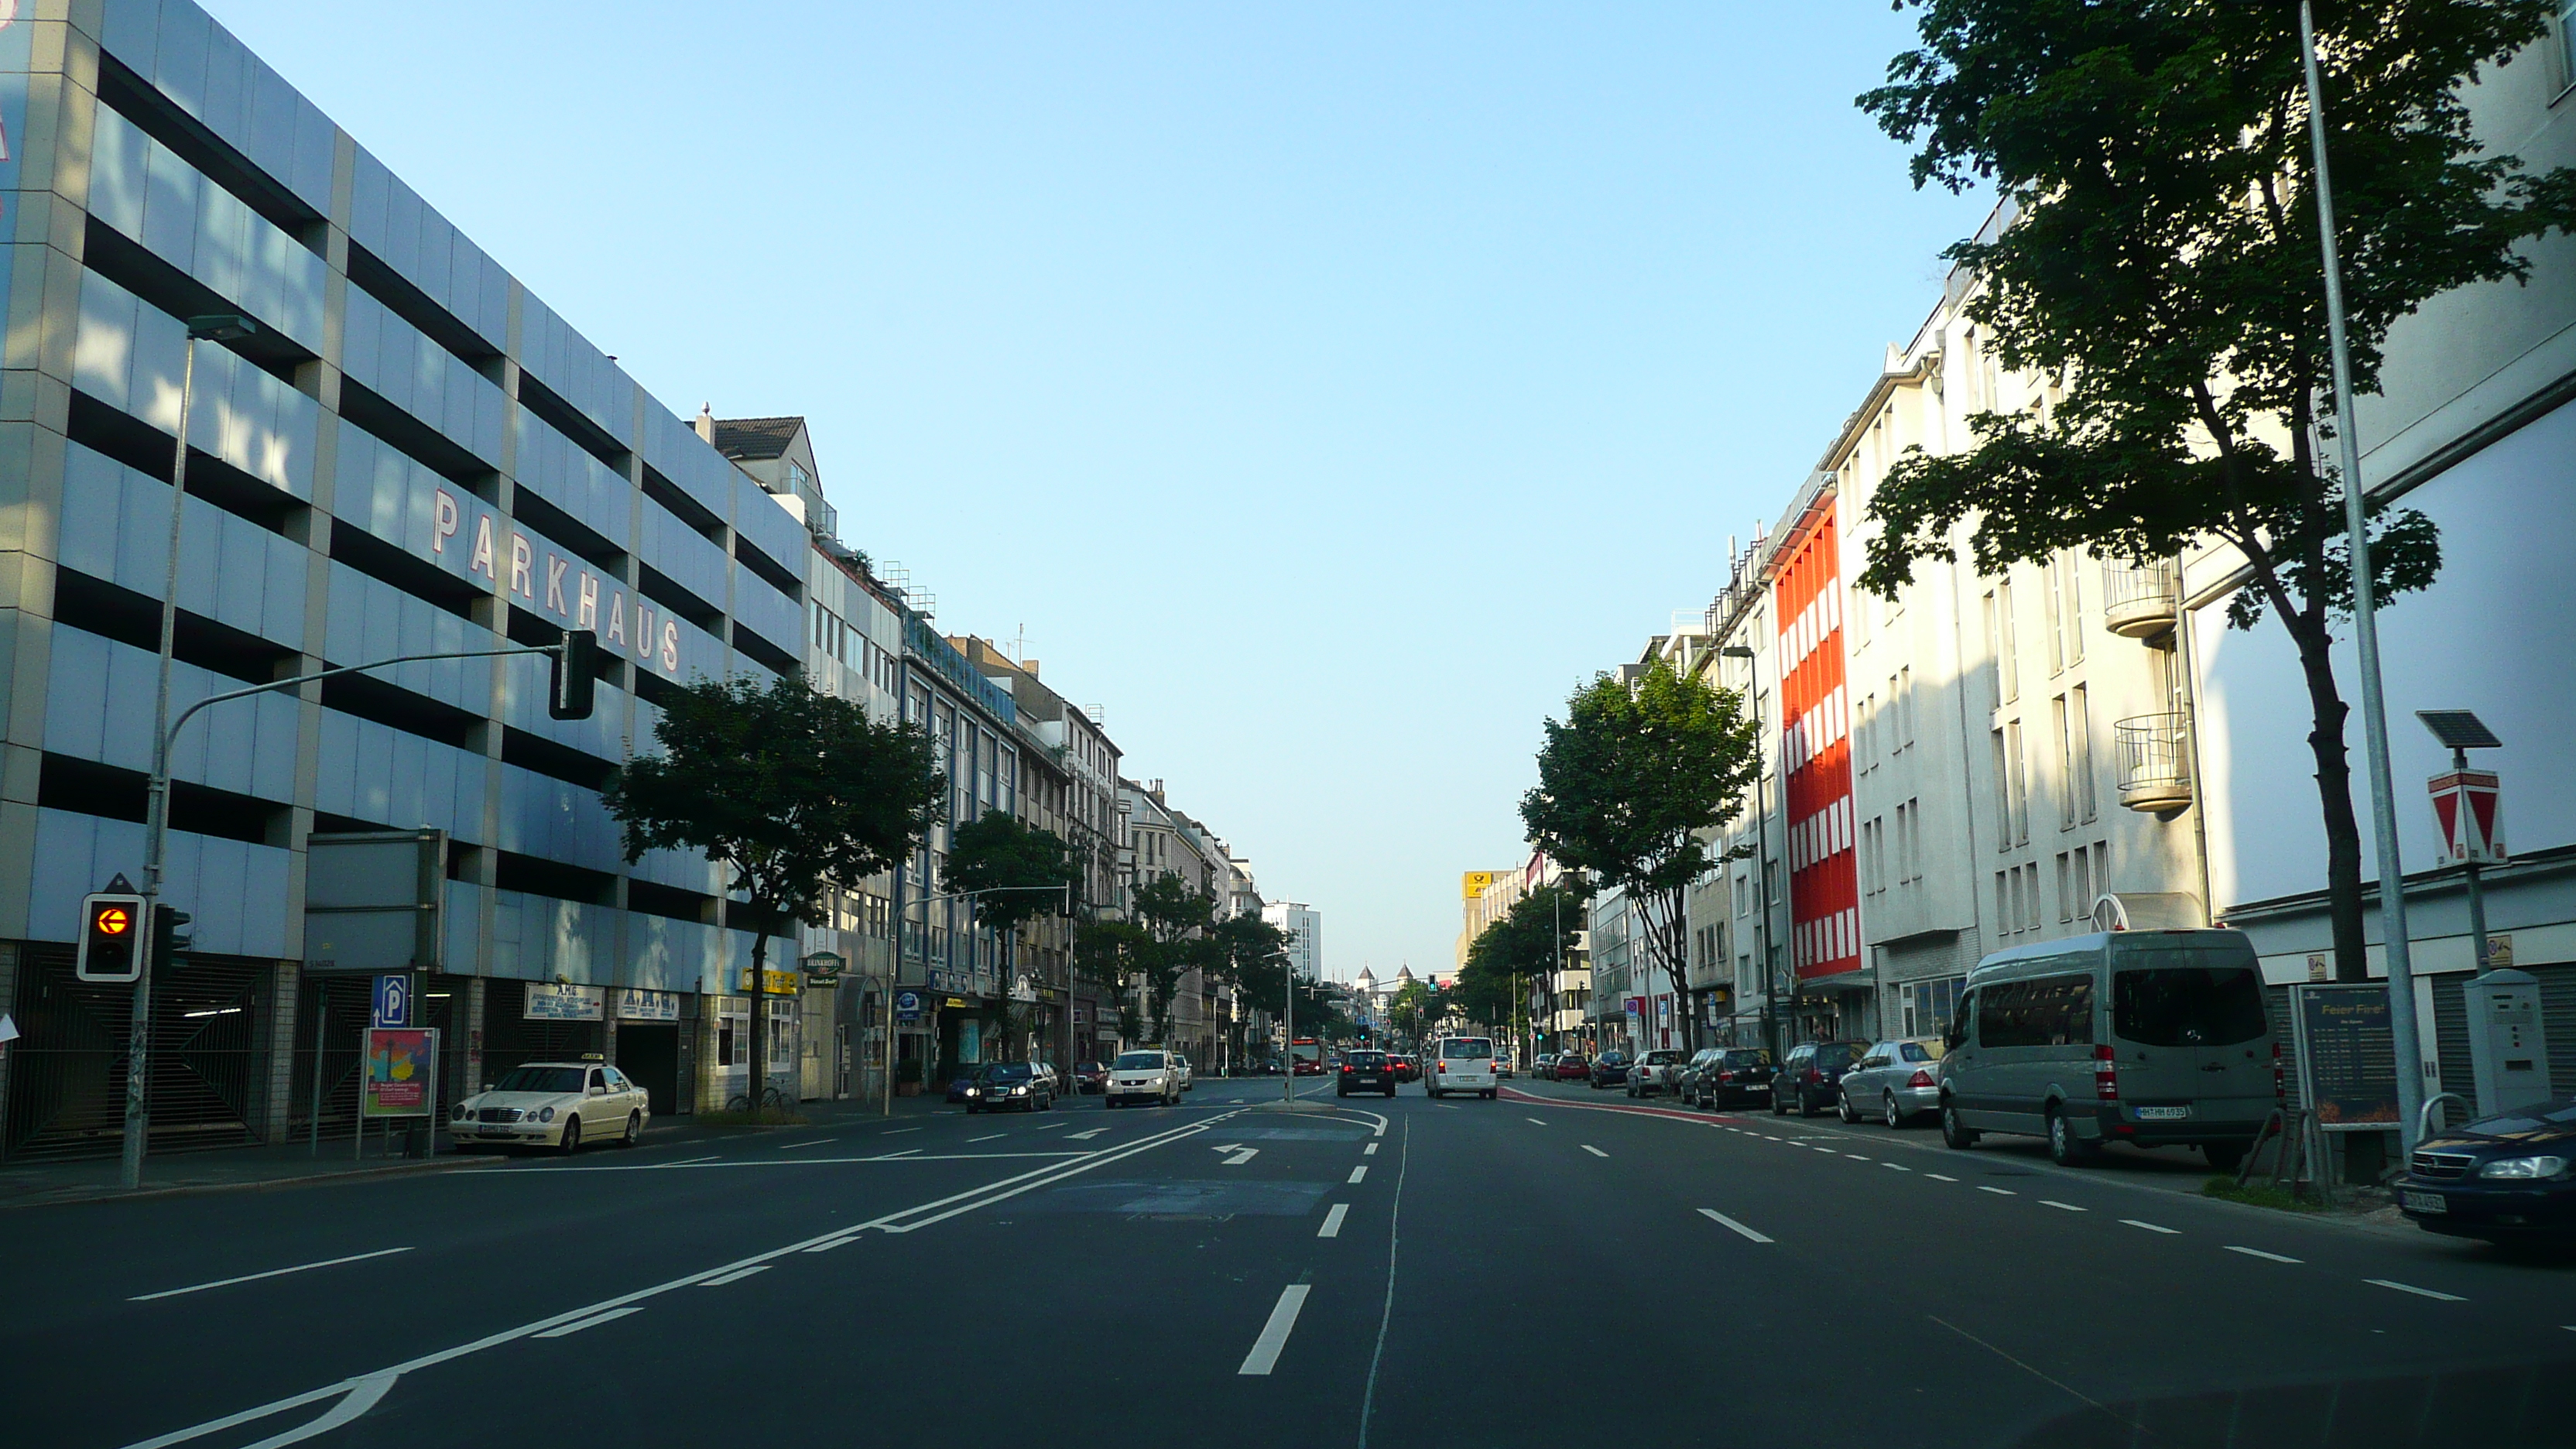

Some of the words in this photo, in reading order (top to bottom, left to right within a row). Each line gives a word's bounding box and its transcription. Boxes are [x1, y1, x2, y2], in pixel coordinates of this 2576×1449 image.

[432, 488, 679, 672] PARKHAUS
[387, 989, 401, 1018] P
[1660, 1002, 1665, 1014] P
[2322, 1004, 2355, 1015] Feier
[2167, 1108, 2184, 1116] 6935
